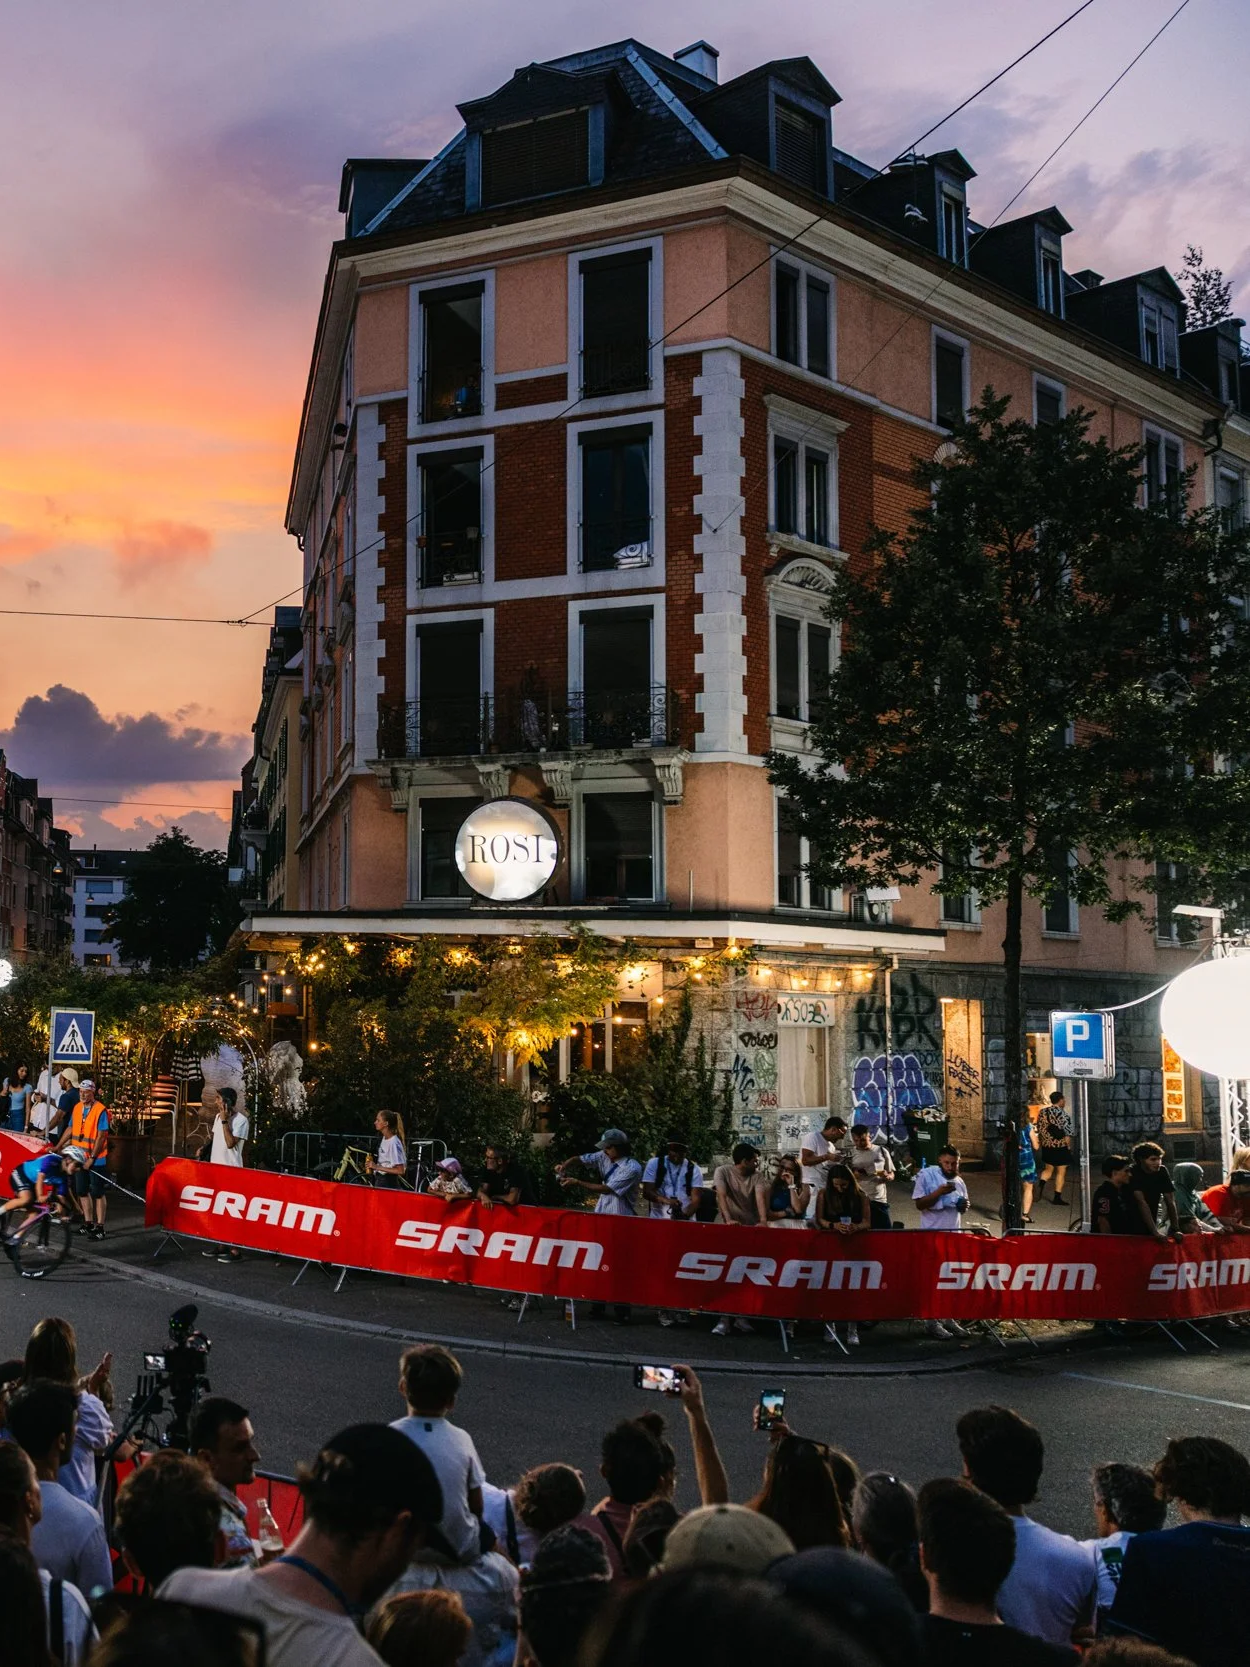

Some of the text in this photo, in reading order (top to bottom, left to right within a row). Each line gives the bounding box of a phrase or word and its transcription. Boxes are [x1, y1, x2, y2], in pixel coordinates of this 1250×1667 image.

[467, 834, 544, 863] ROSI
[1066, 1020, 1090, 1052] P
[179, 1185, 1250, 1291] SRAM SRAM SRAM SRAM SRAM
